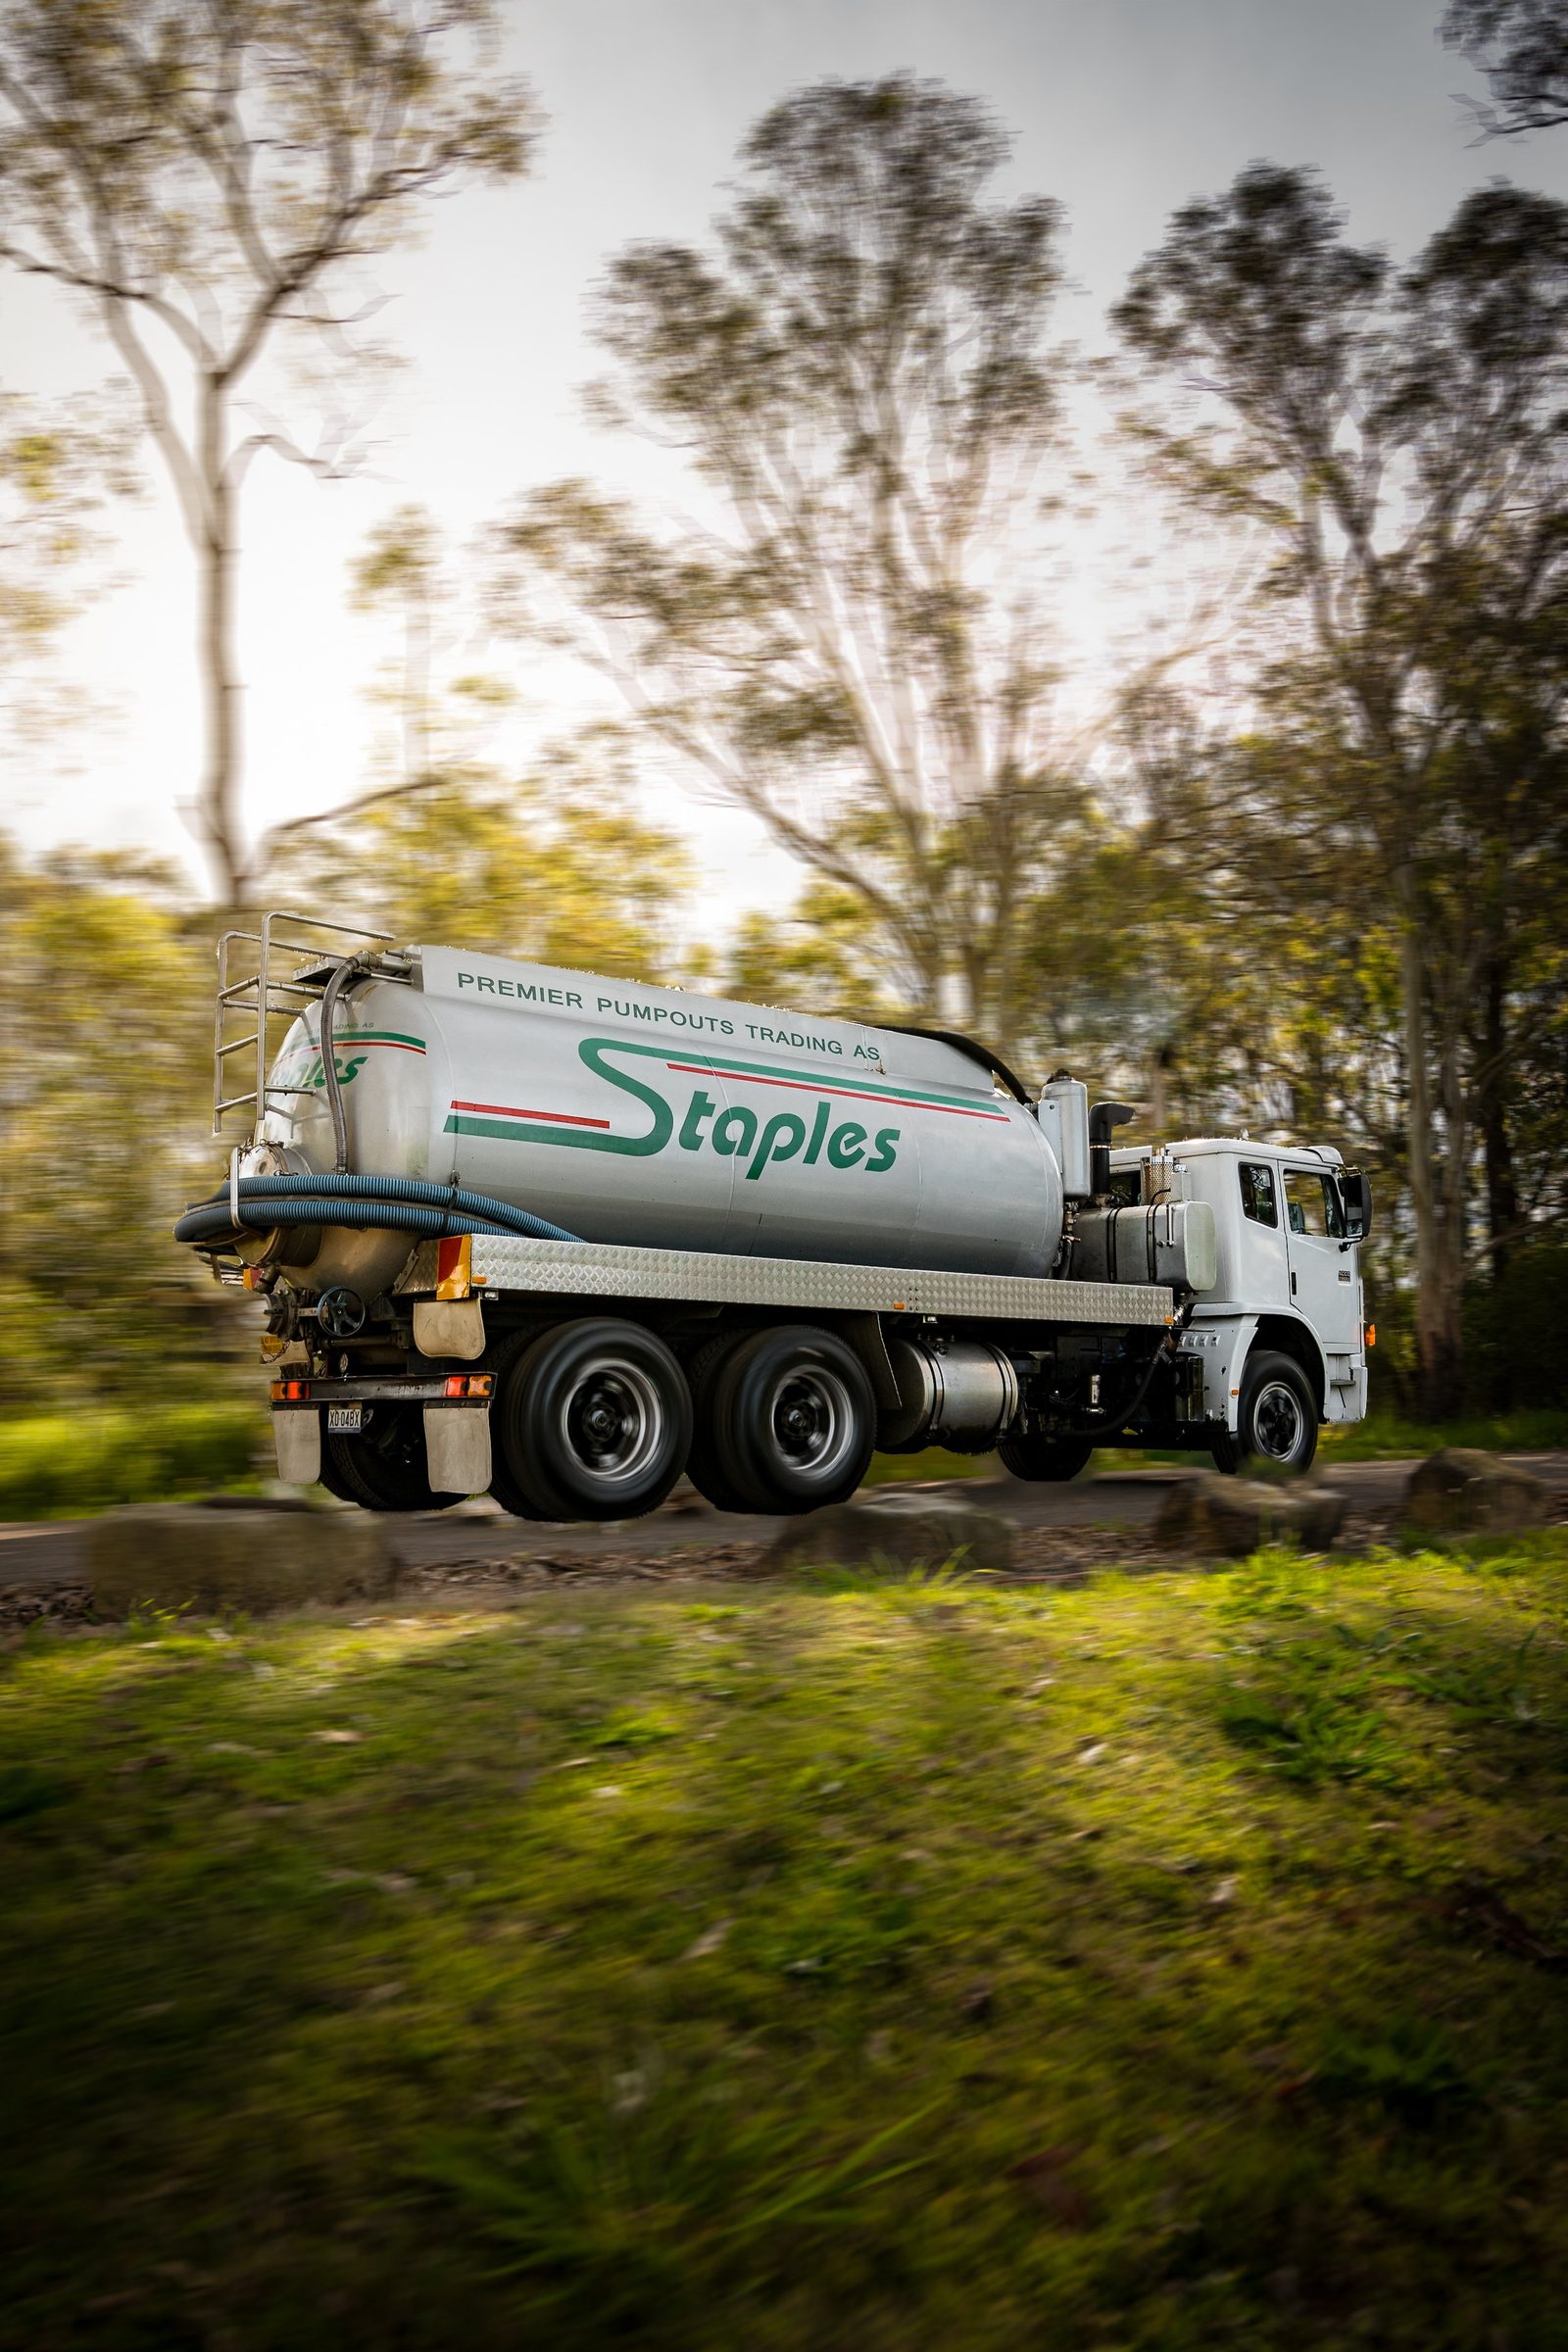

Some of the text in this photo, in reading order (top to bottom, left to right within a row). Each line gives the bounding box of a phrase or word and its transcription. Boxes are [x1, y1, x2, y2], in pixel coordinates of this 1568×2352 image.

[457, 972, 880, 1060] PREMIER PUMPOUTS TRADING AS
[578, 1037, 902, 1181] Staples
